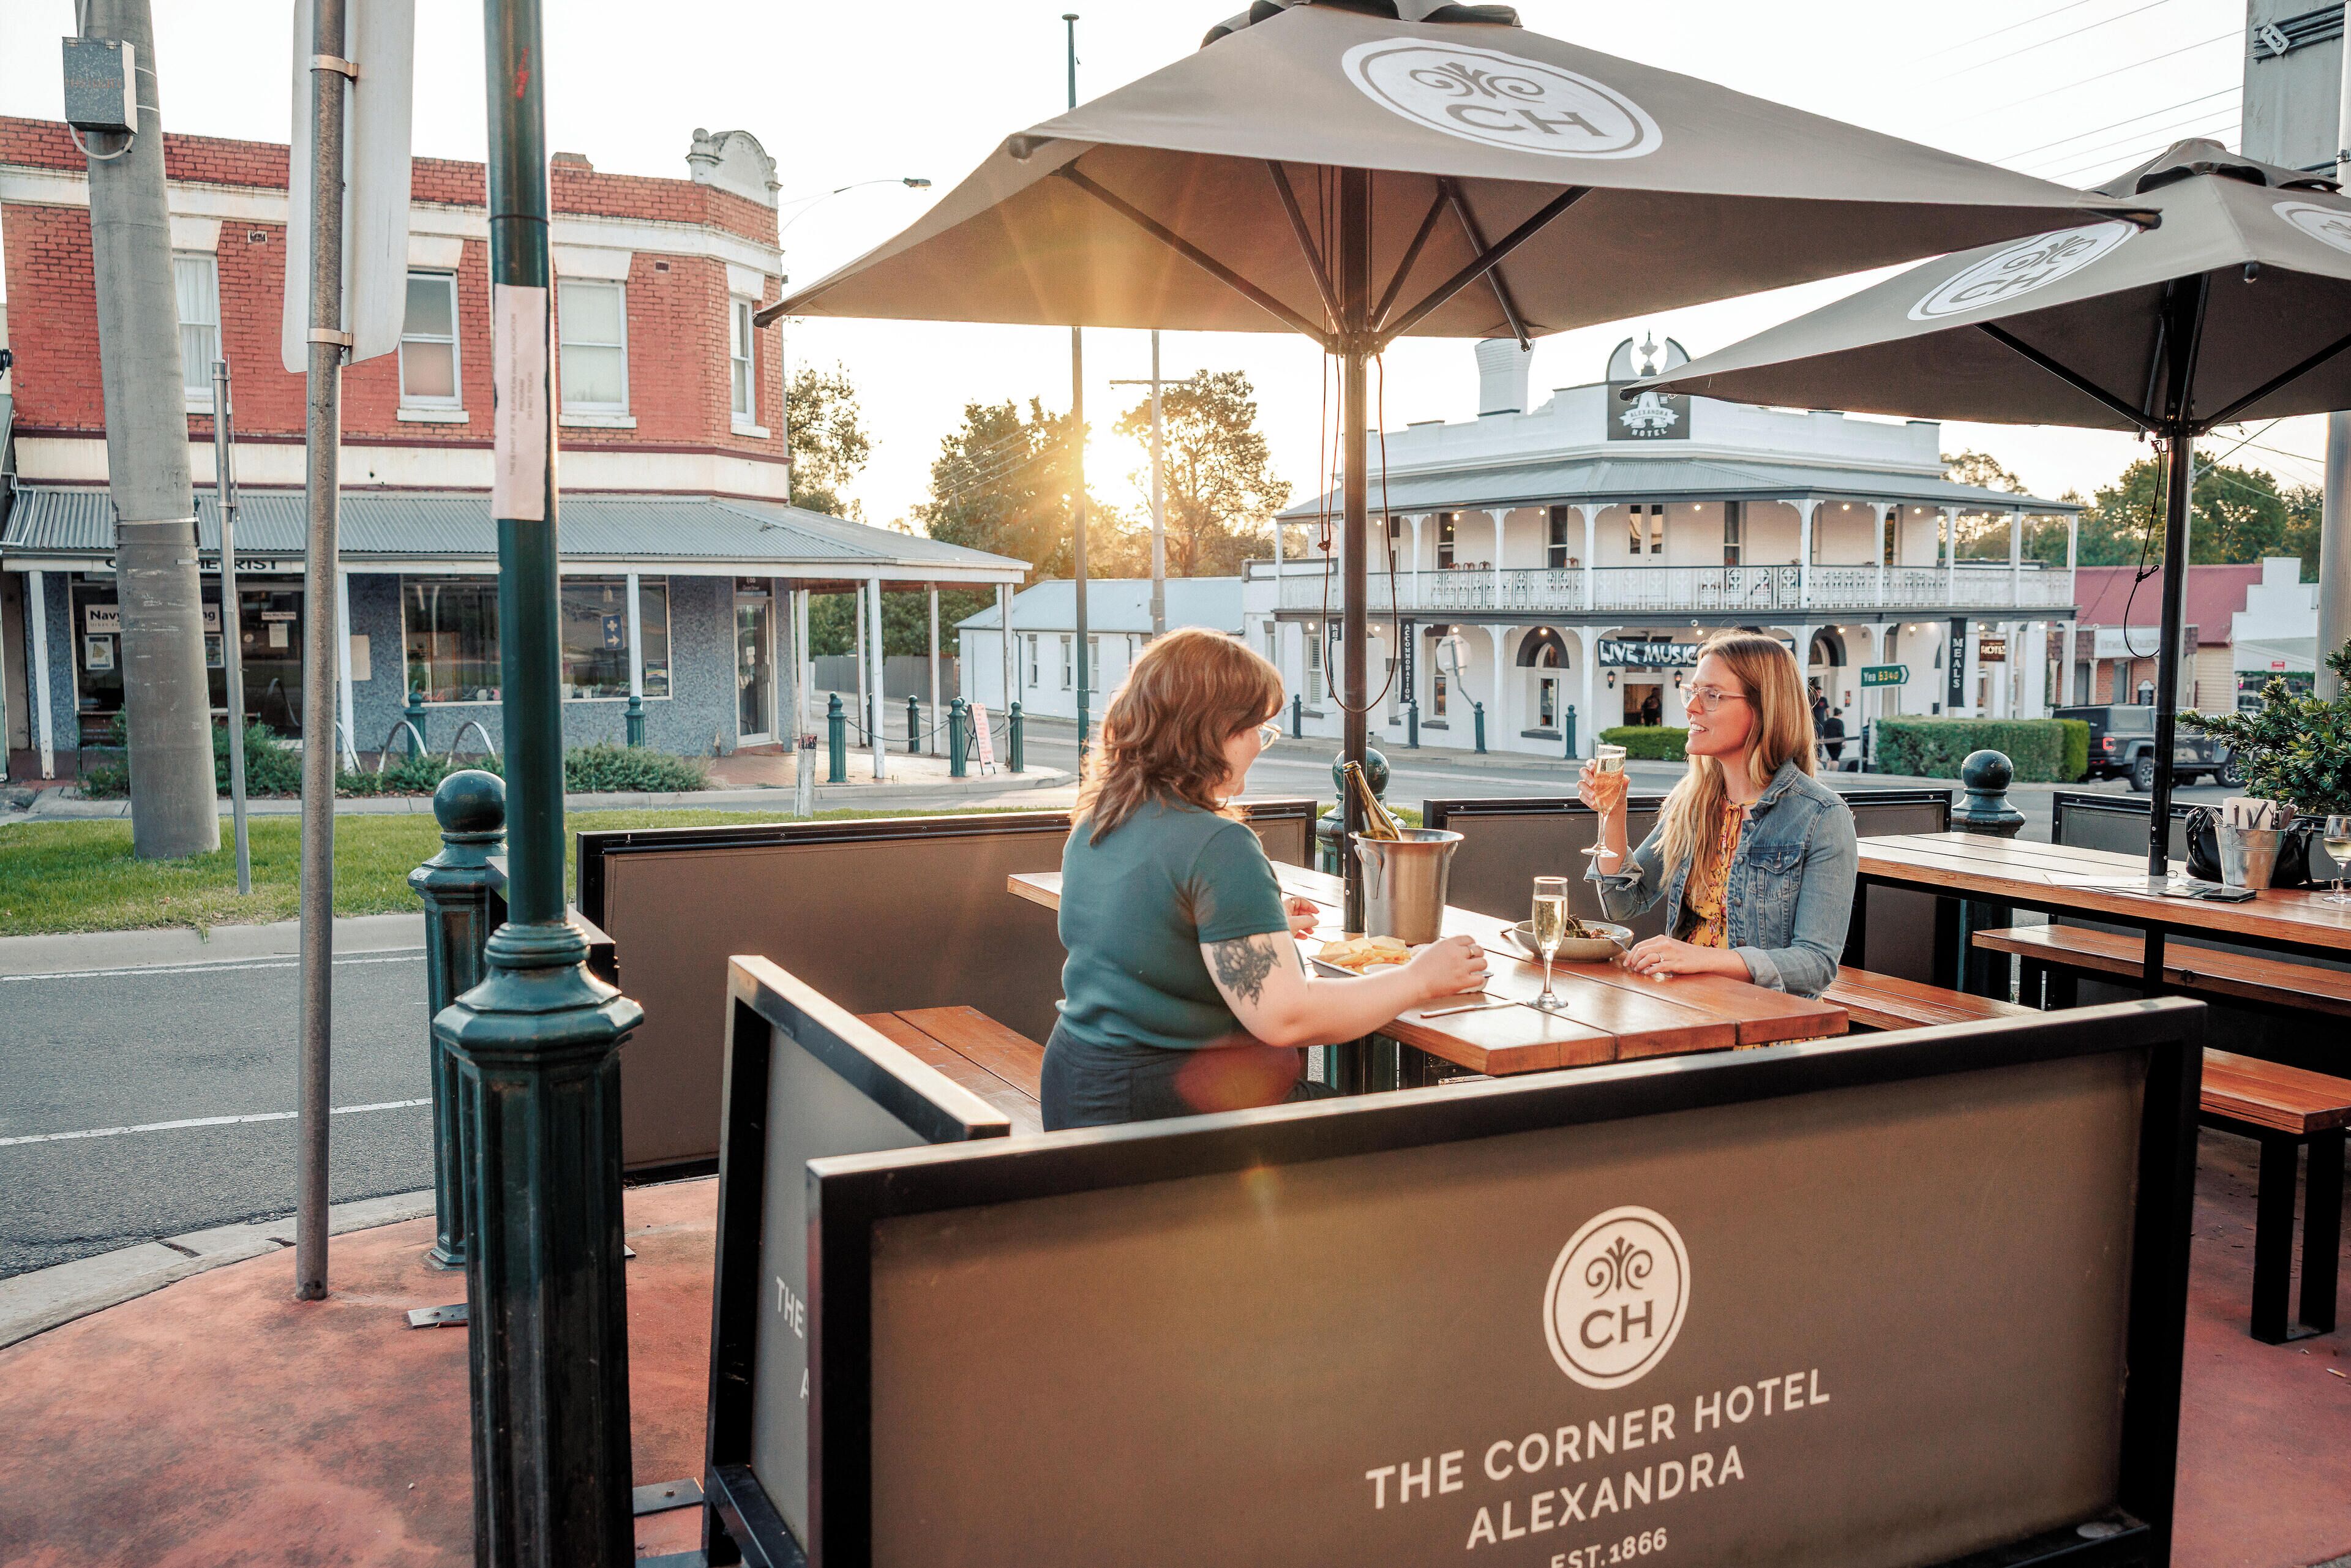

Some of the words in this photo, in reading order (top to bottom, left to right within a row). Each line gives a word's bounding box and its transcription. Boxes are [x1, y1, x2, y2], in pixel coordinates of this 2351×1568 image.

[1445, 103, 1611, 137] CH
[1949, 266, 2061, 303] CH
[1631, 428, 1667, 437] HOTEL
[1599, 641, 1639, 664] LIVE
[1643, 643, 1697, 664] MUSIC
[1952, 638, 1964, 688] MEALS
[1863, 672, 1877, 682] Yea
[776, 1275, 804, 1339] THE
[1580, 1300, 1653, 1349] CH
[1366, 1449, 1464, 1510] THE
[1484, 1403, 1676, 1482] CORNER
[1694, 1368, 1830, 1433] HOTEL
[1466, 1445, 1745, 1550] ALEXANDRA
[1551, 1527, 1668, 1568] EST.1866
